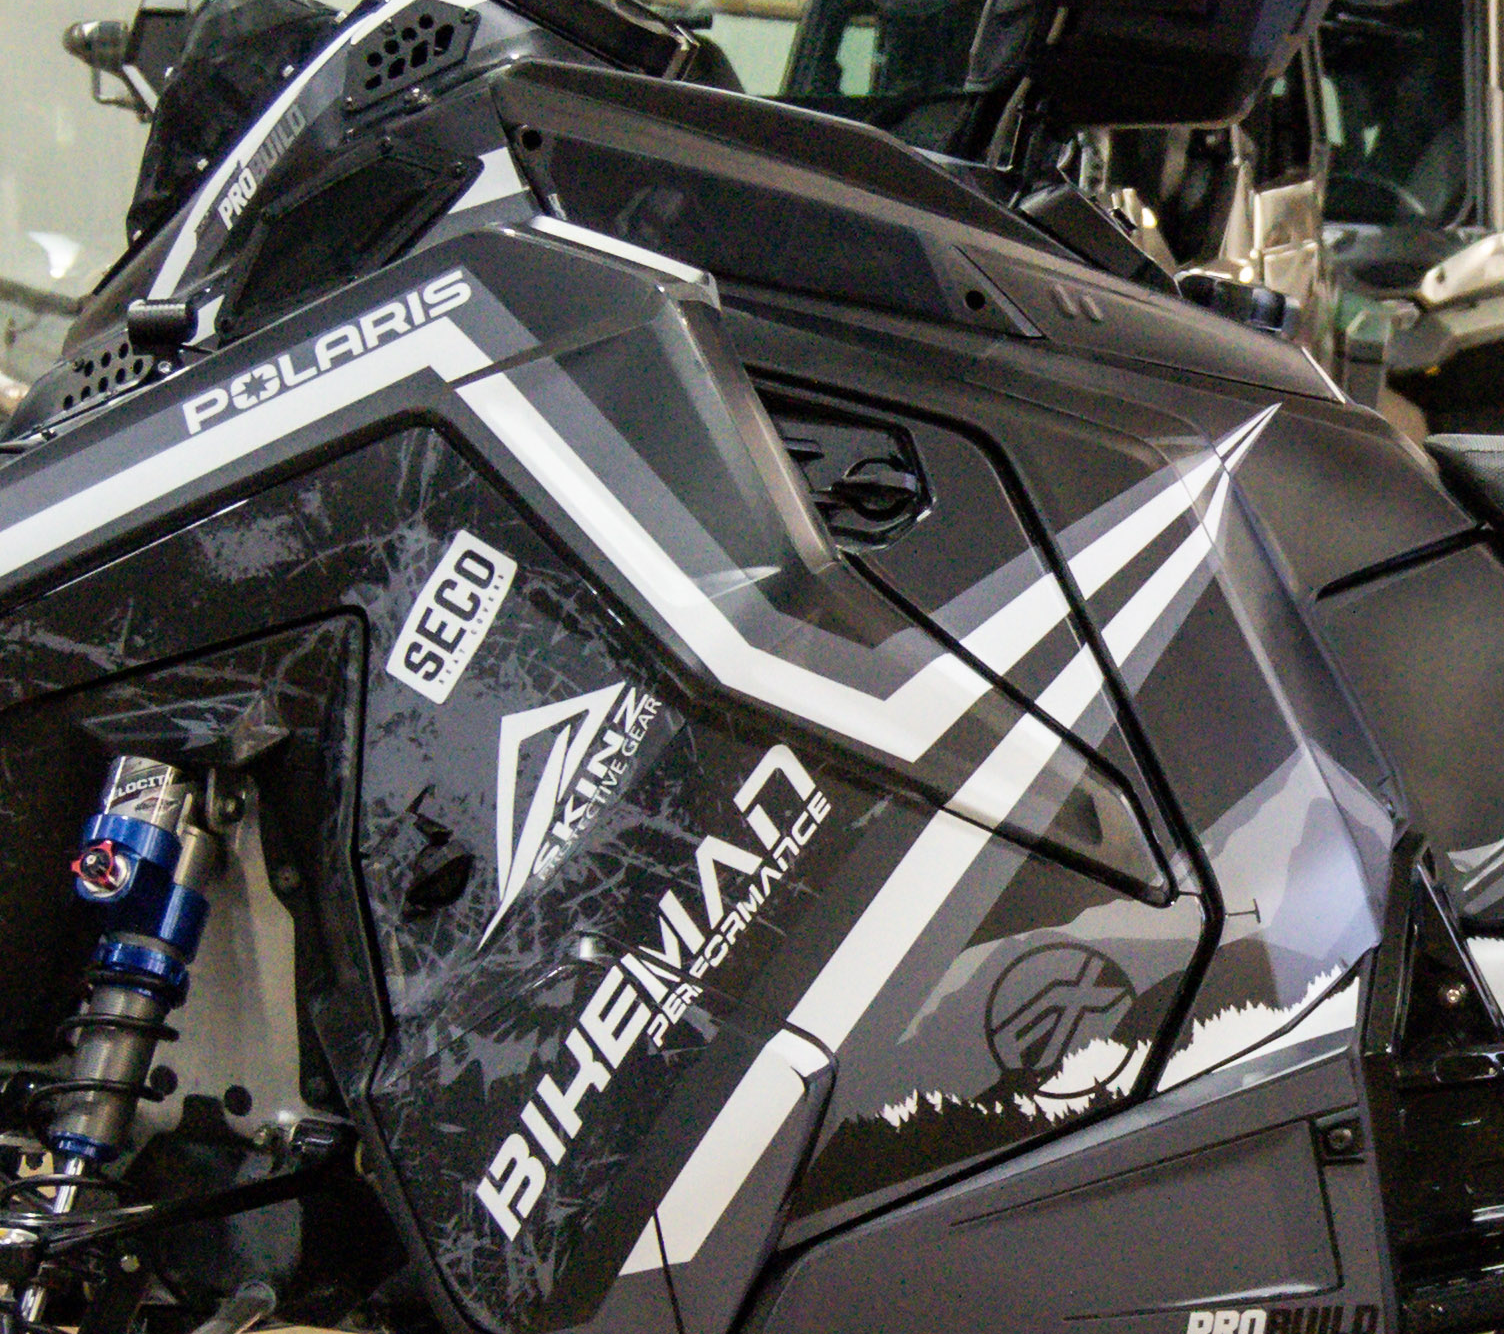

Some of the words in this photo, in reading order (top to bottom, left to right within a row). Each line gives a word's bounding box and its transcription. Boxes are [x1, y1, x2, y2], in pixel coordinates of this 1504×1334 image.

[182, 269, 473, 436] POLARIS
[403, 549, 496, 682] SECO
[532, 686, 649, 875] SKINZ
[621, 695, 663, 758] GEAR
[646, 790, 832, 1048] PERFORMANCE
